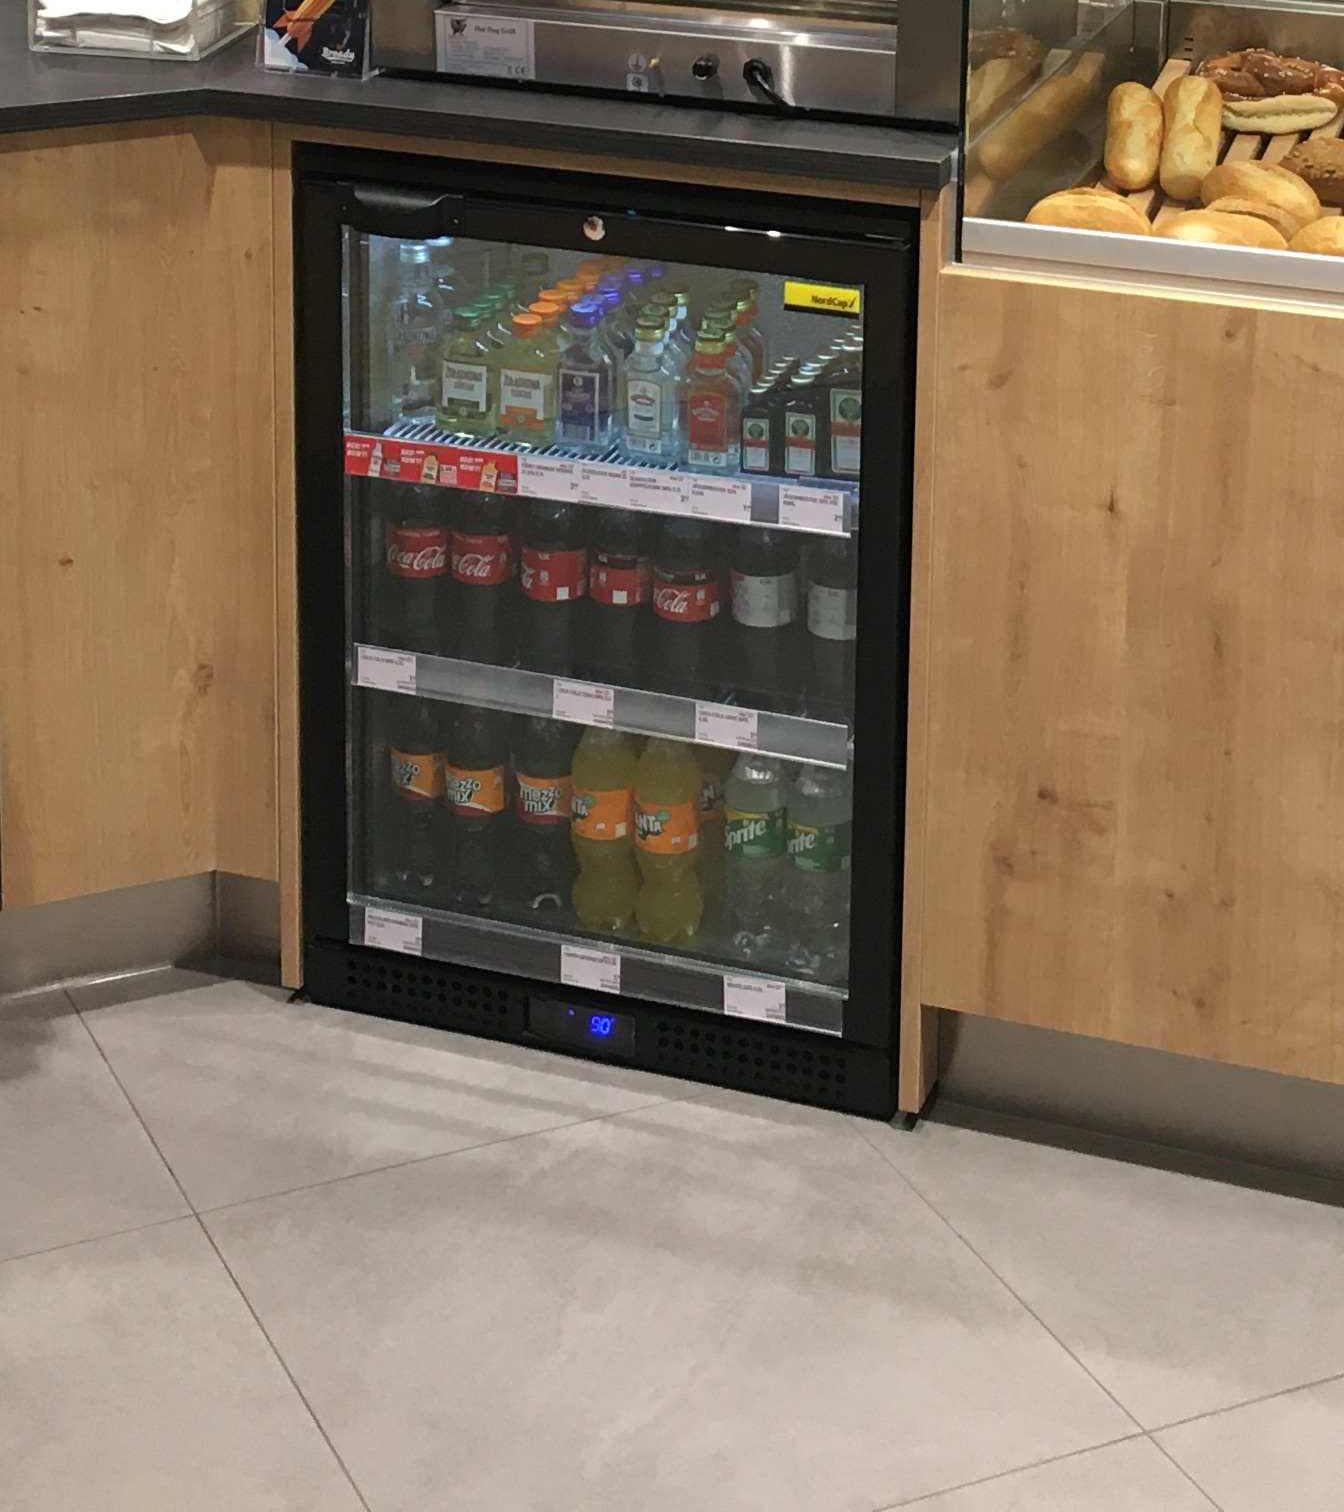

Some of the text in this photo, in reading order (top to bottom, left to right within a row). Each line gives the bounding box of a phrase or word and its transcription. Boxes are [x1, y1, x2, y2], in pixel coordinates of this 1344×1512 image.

[811, 295, 848, 310] NordCap
[520, 786, 561, 801] mezzo
[525, 798, 555, 813] mix
